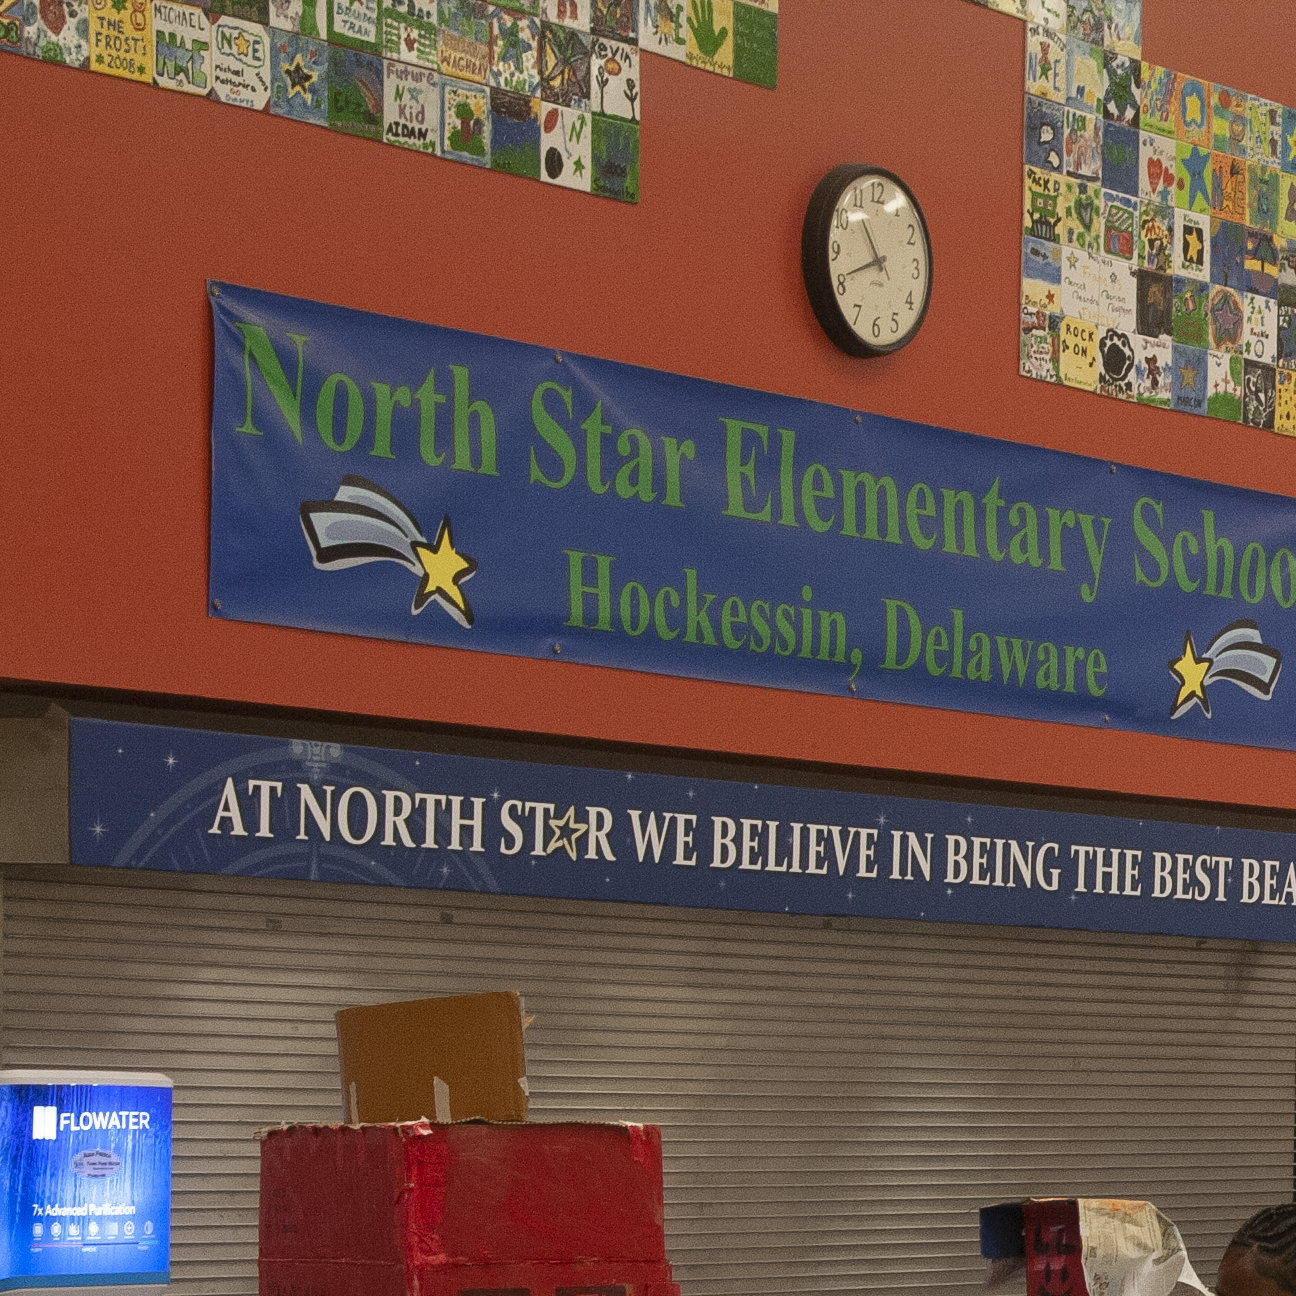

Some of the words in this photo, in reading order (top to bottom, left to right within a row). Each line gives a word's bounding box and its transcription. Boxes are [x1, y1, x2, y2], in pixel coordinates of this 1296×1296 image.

[97, 16, 125, 35] THE
[154, 3, 206, 31] MICHAEL
[342, 19, 371, 38] TRAN
[107, 53, 136, 74] 2008
[386, 62, 434, 84] Future
[400, 102, 426, 124] Kid
[386, 122, 428, 141] AIDAN
[853, 187, 864, 208] 11
[870, 182, 885, 205] 12
[835, 207, 849, 230] 10
[906, 224, 916, 246] 2
[831, 240, 841, 261] 9
[911, 258, 920, 280] 3
[837, 273, 846, 295] 8
[905, 290, 914, 310] 4
[852, 303, 862, 326] 7
[890, 312, 899, 333] 5
[872, 316, 881, 338] 6
[1066, 324, 1094, 343] ROCK
[1073, 343, 1088, 358] ON
[235, 321, 500, 477] North
[529, 380, 697, 508] Star
[719, 417, 1113, 603] Elementary
[563, 549, 863, 683] Hockessin,
[880, 598, 1109, 697] Delaware
[207, 776, 282, 838] AT
[296, 783, 486, 853] NORTH
[627, 810, 698, 867] WE
[710, 816, 878, 879] BELIEVE
[889, 830, 934, 882] IN
[945, 836, 1062, 892] BEING
[1071, 845, 1142, 896] THE
[1151, 852, 1232, 903] BEST
[60, 1111, 150, 1132] FLOWATER
[45, 1203, 88, 1217] Advanced
[88, 1203, 136, 1217] Purification
